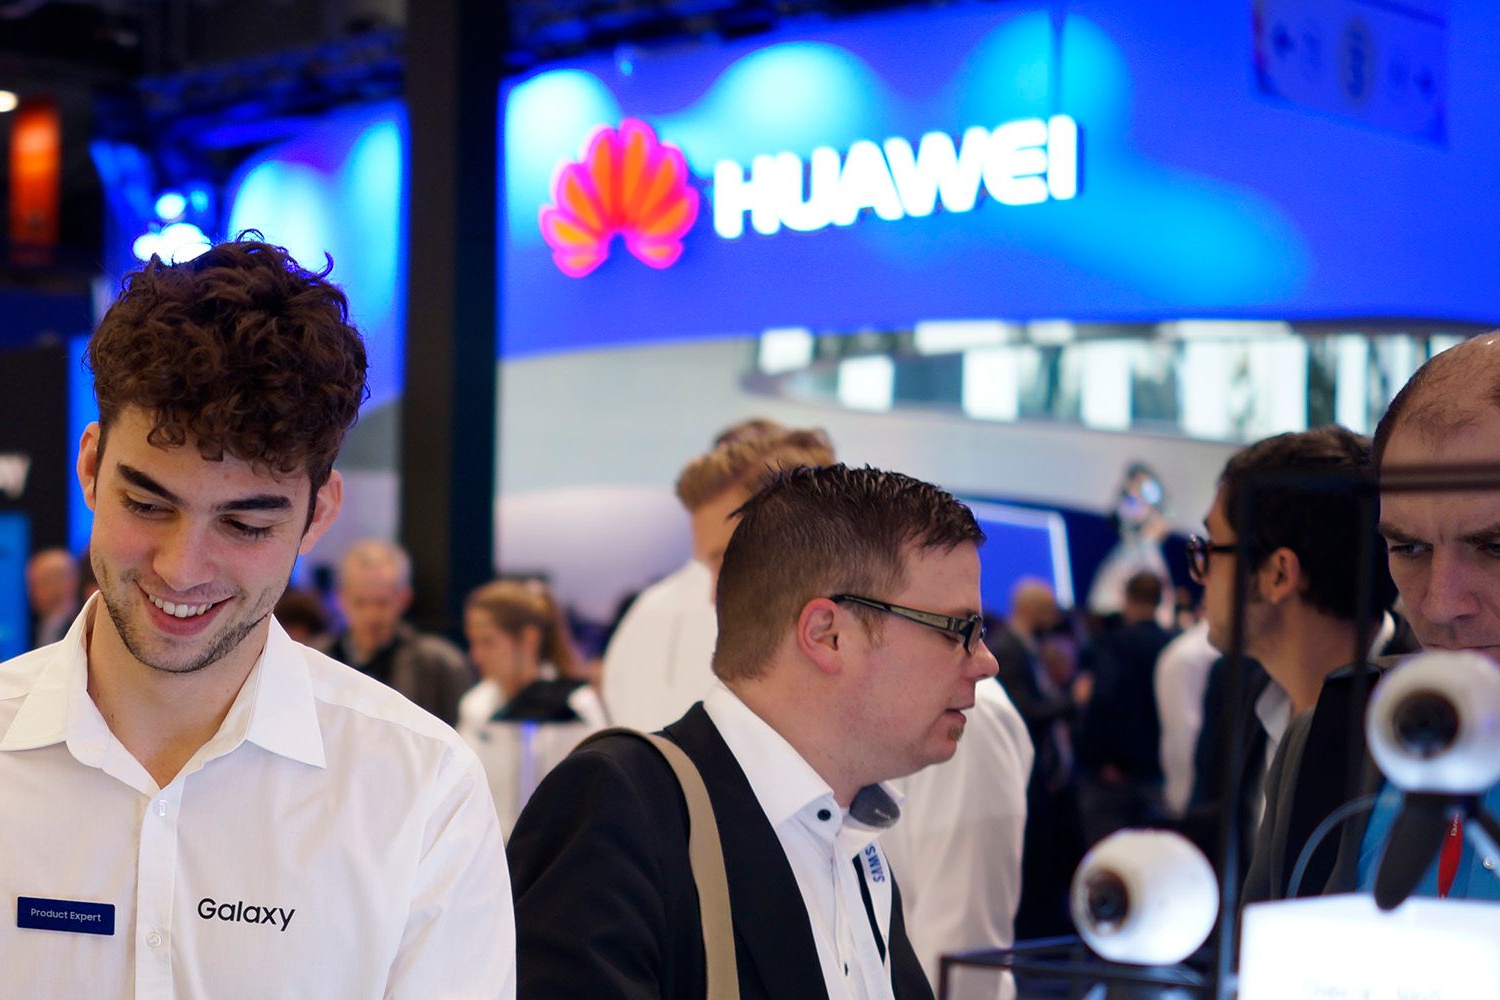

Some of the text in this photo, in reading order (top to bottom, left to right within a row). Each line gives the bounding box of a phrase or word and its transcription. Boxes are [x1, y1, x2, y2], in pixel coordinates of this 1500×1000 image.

[713, 113, 1078, 239] HUAWEI
[30, 908, 102, 922] Product Expert
[197, 897, 296, 932] Galaxy
